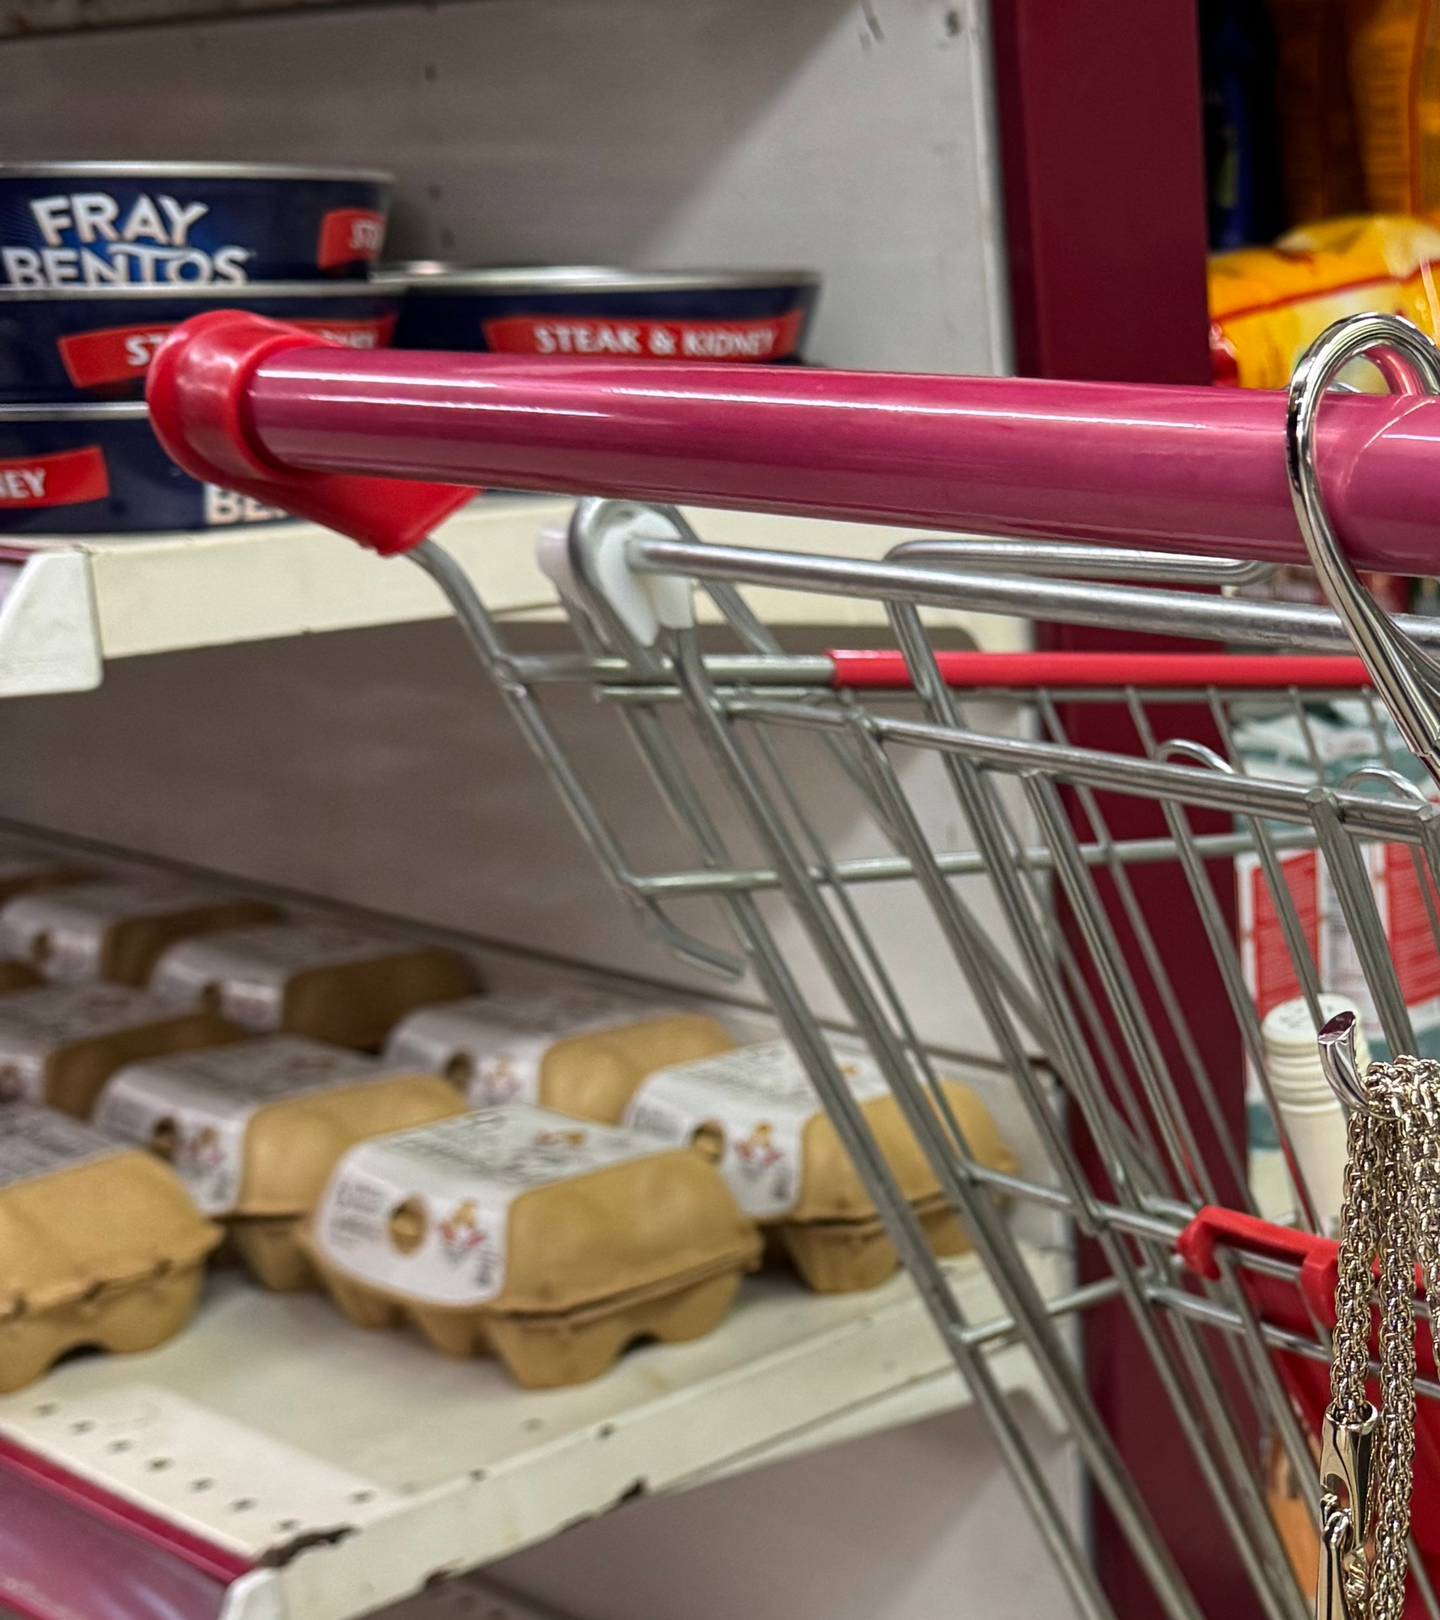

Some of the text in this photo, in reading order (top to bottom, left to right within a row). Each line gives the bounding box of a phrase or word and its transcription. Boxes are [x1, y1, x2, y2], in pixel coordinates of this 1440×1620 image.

[31, 192, 209, 246] FRAY
[3, 244, 249, 286] BENTOS
[534, 325, 776, 357] STEAK & KIDNEY
